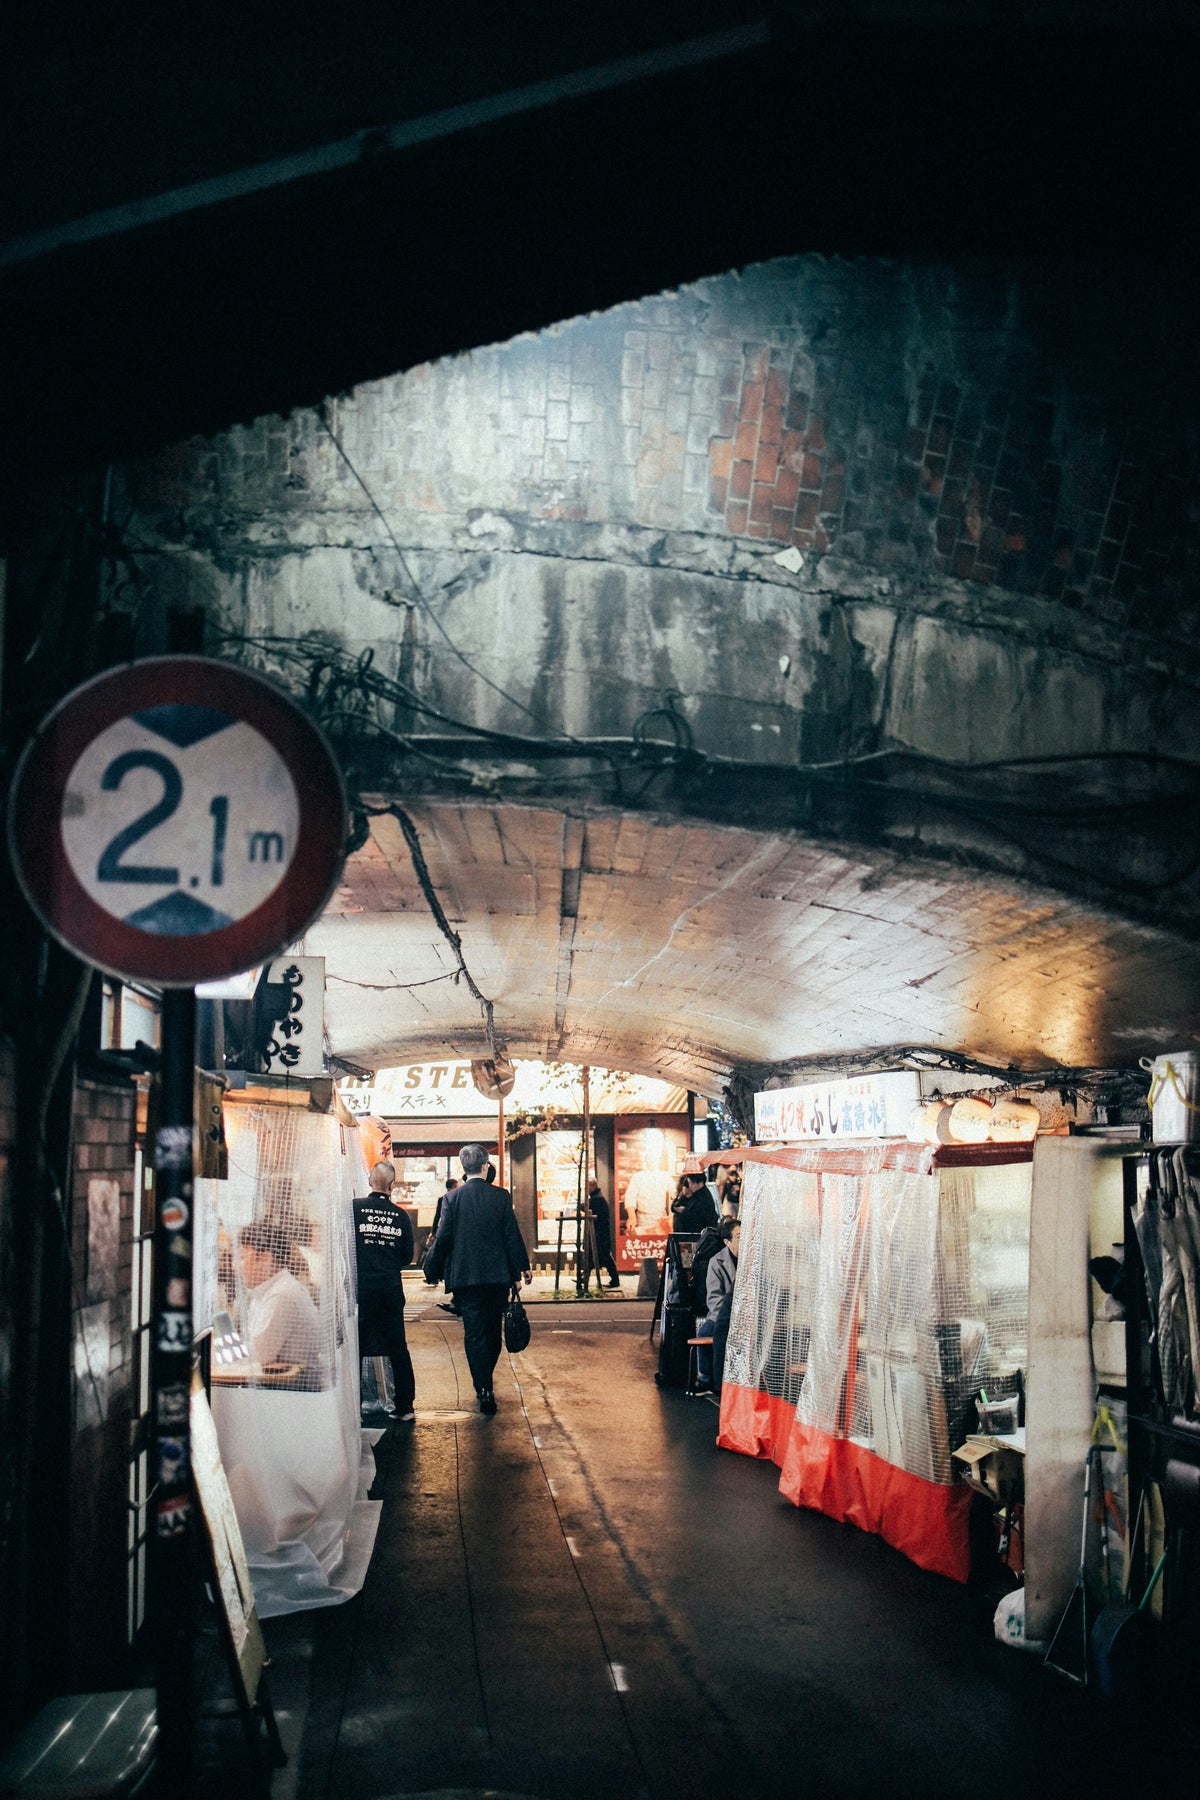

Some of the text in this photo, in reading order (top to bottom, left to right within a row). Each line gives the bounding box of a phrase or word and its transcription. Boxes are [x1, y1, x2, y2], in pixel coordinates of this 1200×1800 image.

[404, 1066, 518, 1089] STE
[400, 1094, 447, 1109] ステーキ
